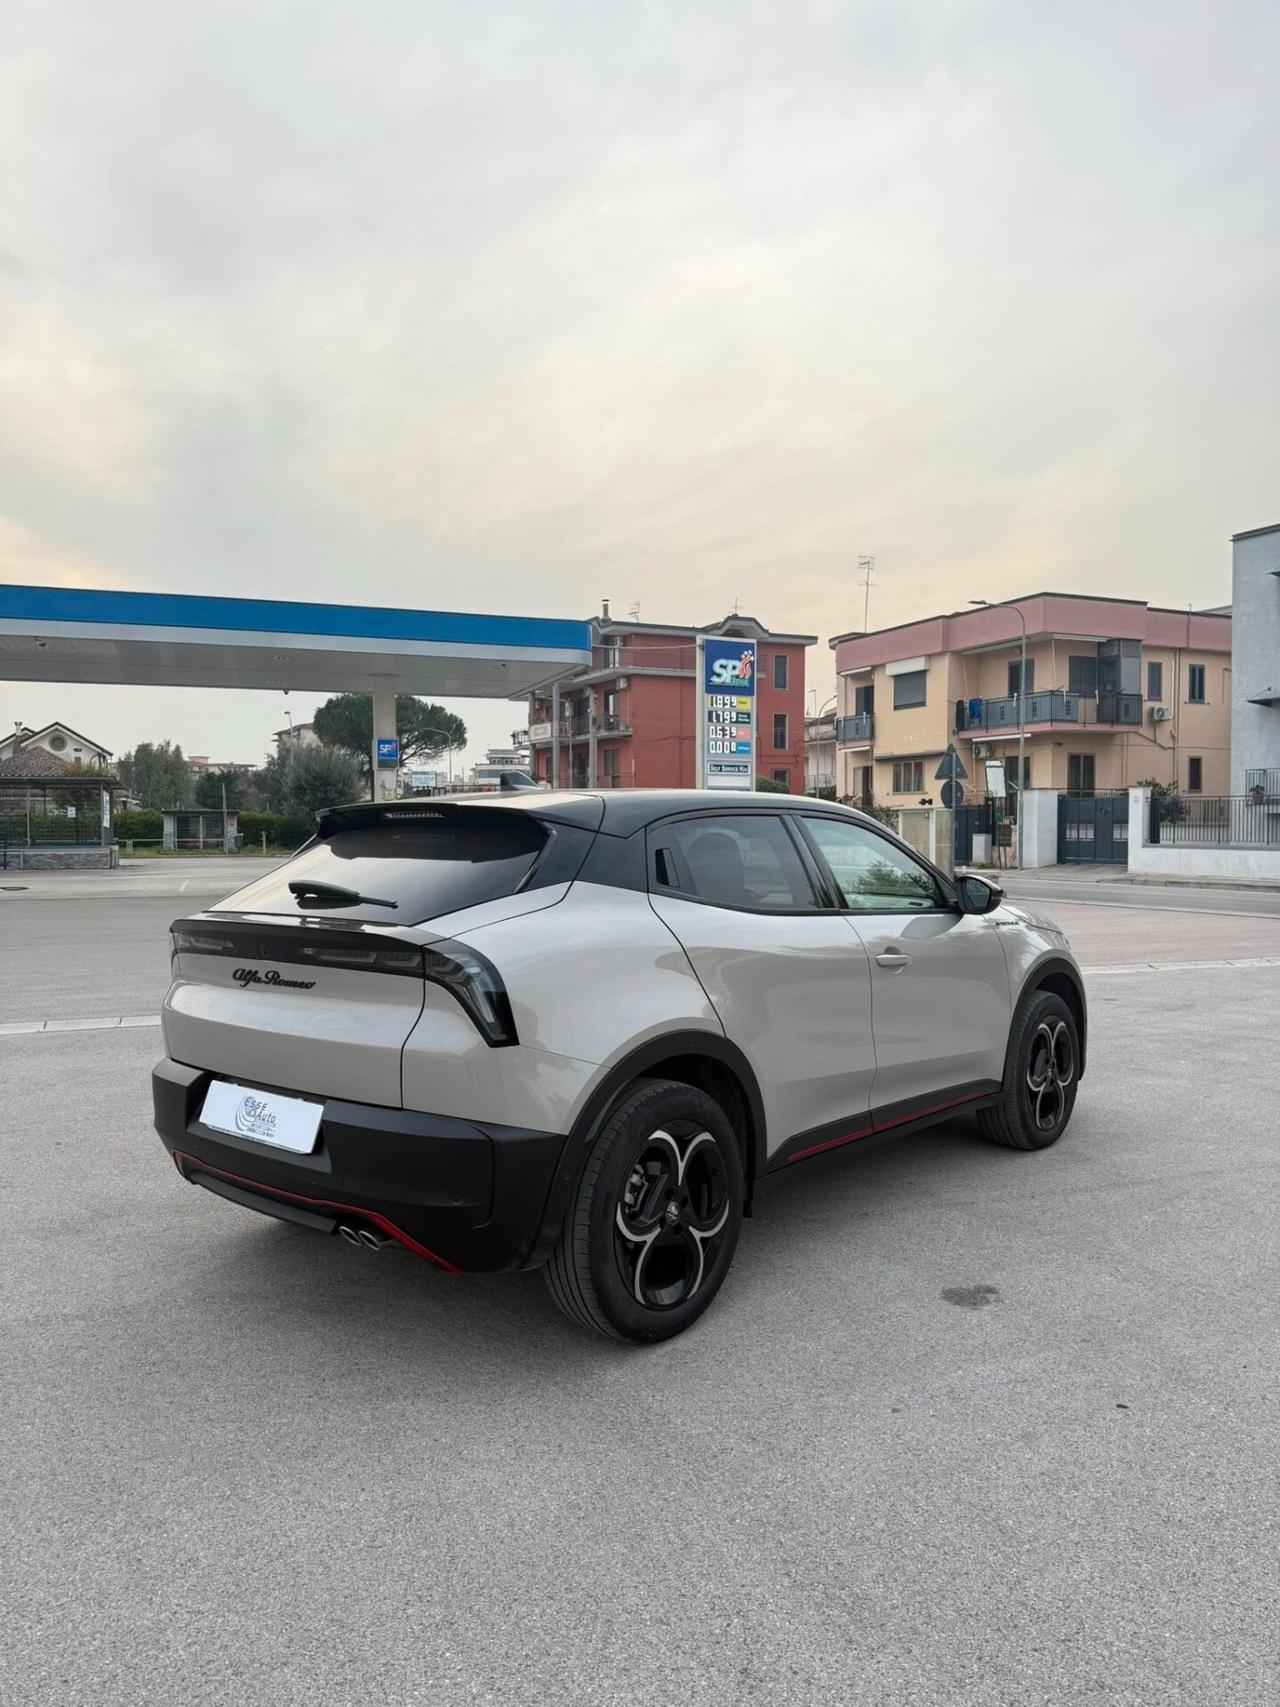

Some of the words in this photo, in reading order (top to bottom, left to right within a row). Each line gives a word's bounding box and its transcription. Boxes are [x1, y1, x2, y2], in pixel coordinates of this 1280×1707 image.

[709, 659, 739, 682] SP
[232, 968, 262, 987] Alfa
[262, 970, 316, 989] Romeo
